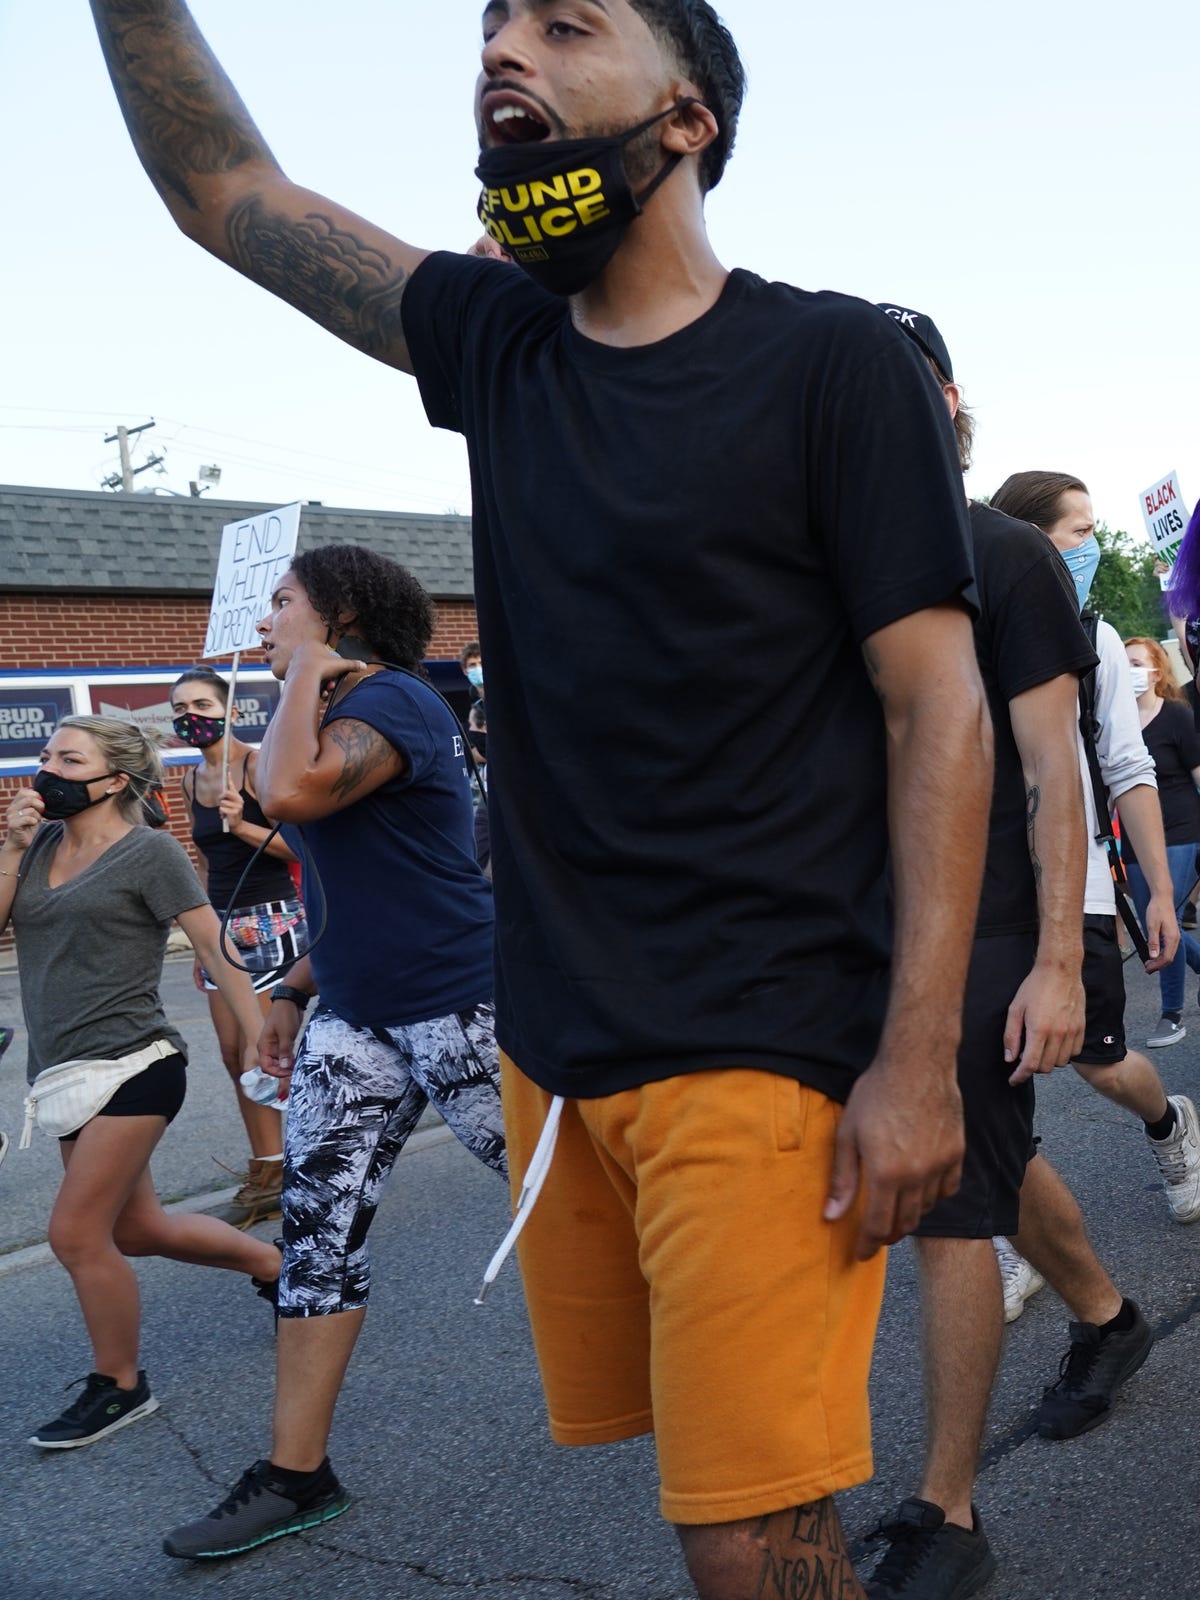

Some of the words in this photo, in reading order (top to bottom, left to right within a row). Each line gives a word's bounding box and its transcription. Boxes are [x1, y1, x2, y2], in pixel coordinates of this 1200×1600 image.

[482, 168, 601, 214] EFUND
[885, 309, 918, 328] CK
[1145, 480, 1176, 515] BLACK
[233, 515, 282, 563] END
[1153, 509, 1183, 541] LIVES
[1157, 538, 1184, 566] MAT
[217, 553, 290, 606] WHITE
[206, 602, 269, 653] SUPREMA
[0, 707, 45, 723] BUD
[233, 711, 268, 728] GHT
[235, 698, 260, 713] UD
[0, 722, 55, 740] IGHT
